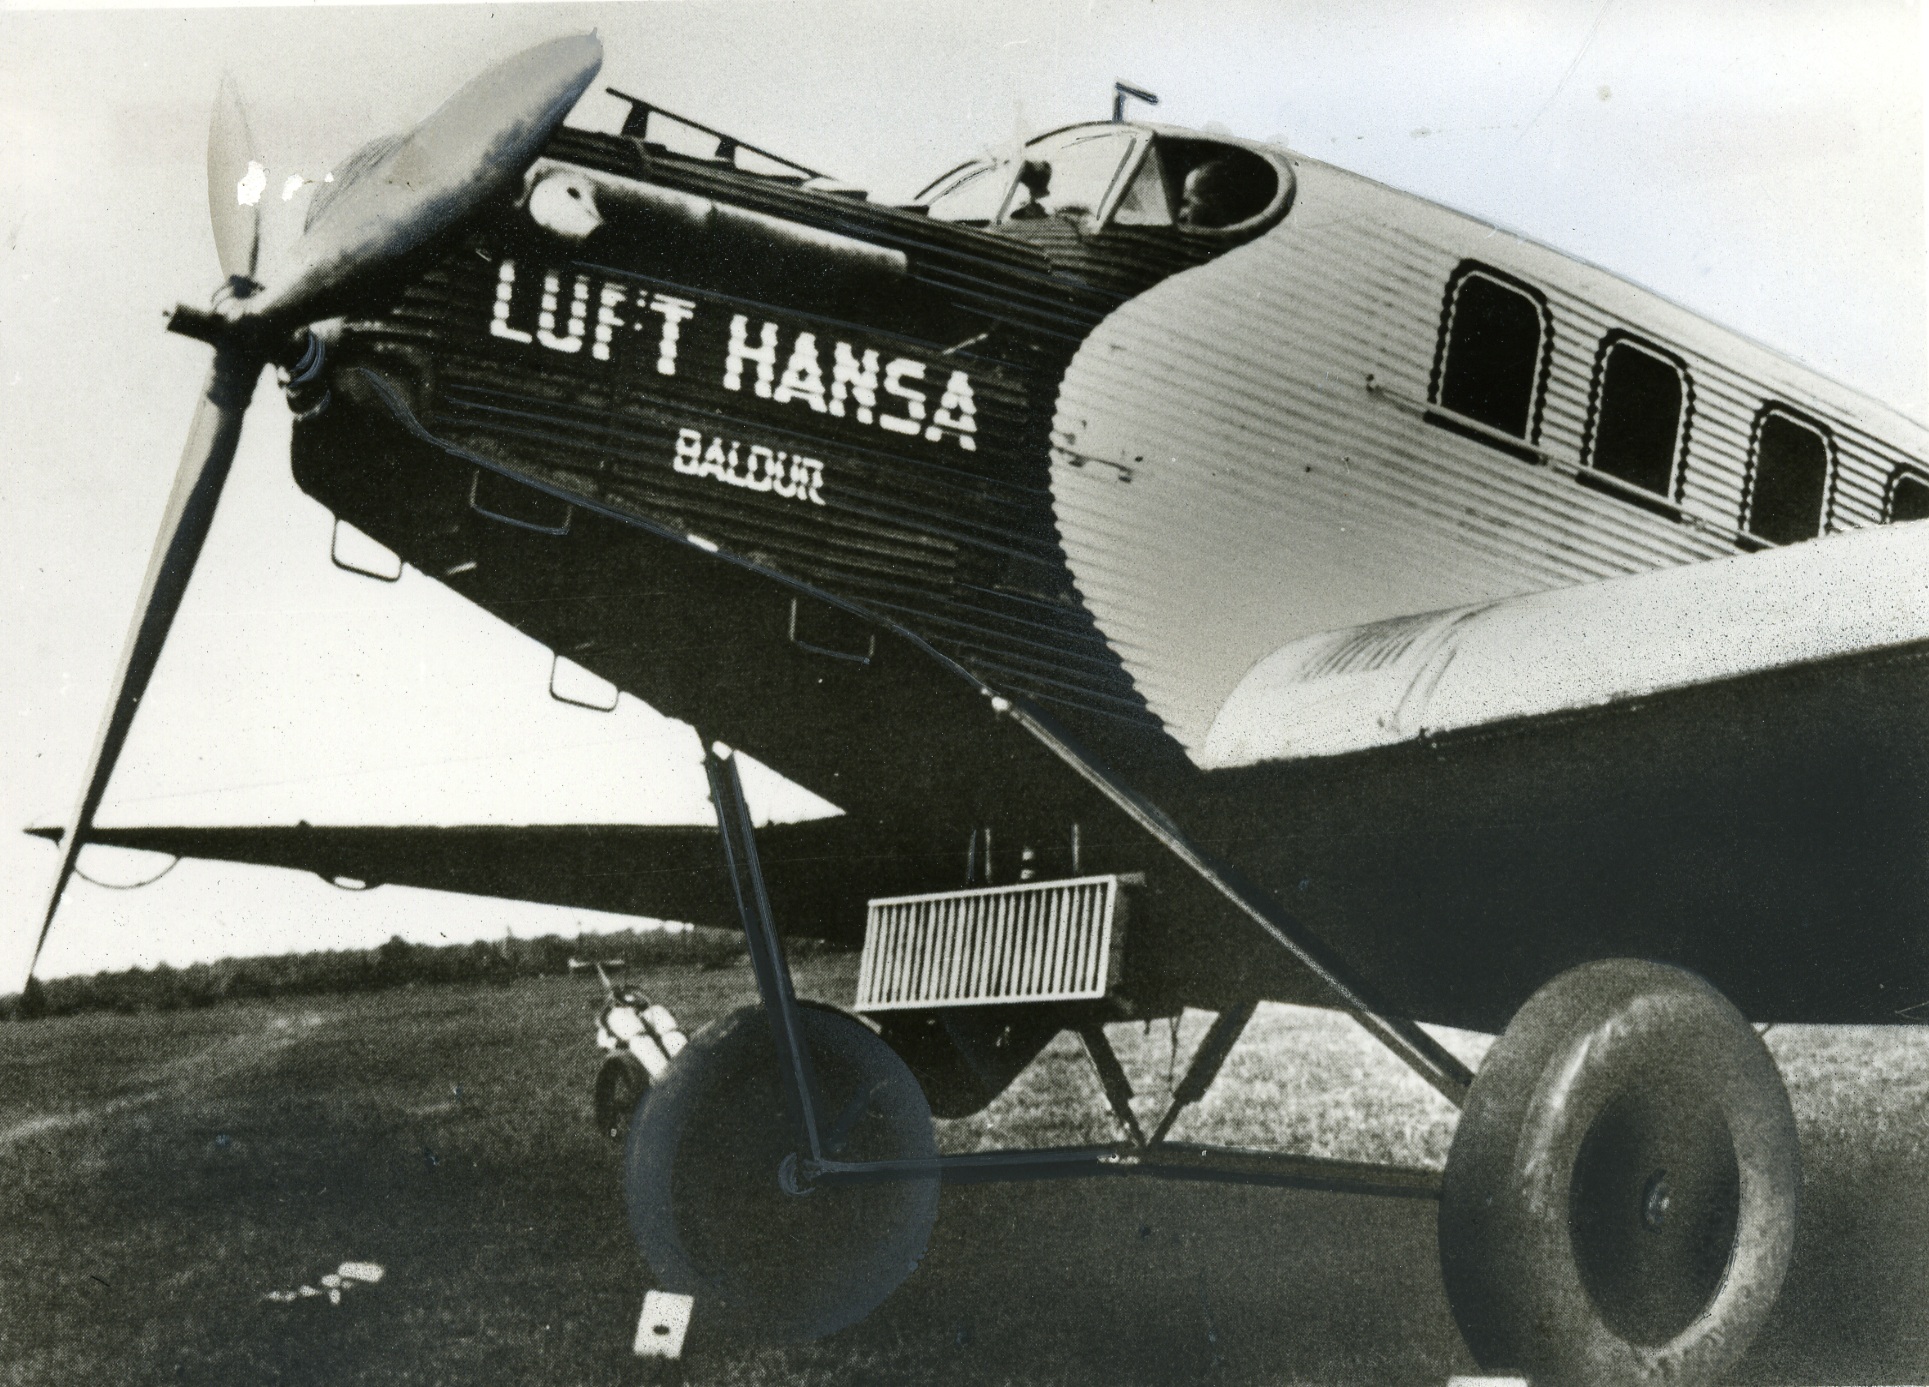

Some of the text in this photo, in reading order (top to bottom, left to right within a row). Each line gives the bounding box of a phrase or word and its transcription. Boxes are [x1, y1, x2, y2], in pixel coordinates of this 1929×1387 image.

[490, 260, 977, 451] LUFT HANSA
[673, 428, 826, 505] BALDUR
